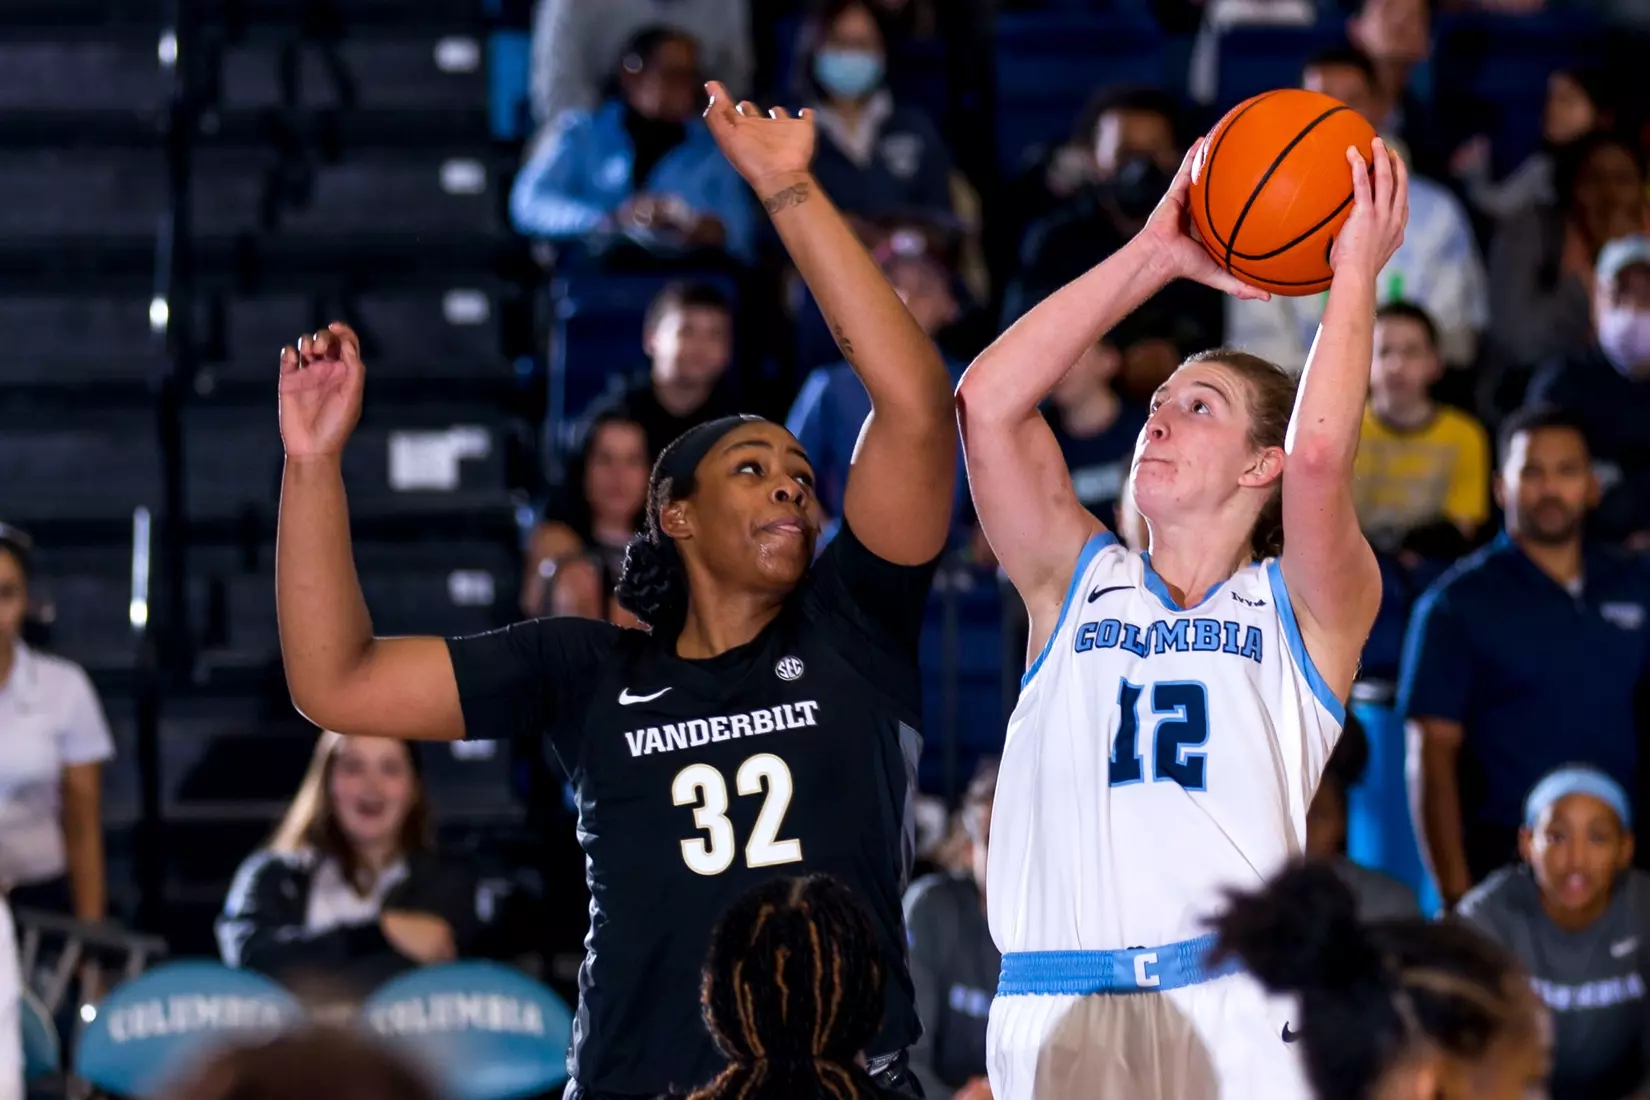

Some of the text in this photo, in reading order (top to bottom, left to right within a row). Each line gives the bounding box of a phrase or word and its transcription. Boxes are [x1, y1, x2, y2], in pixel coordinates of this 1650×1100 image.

[776, 657, 803, 679] SEC
[624, 700, 819, 757] VANDERBILT
[1108, 676, 1211, 792] 12
[672, 753, 803, 876] 32
[1133, 952, 1161, 987] C
